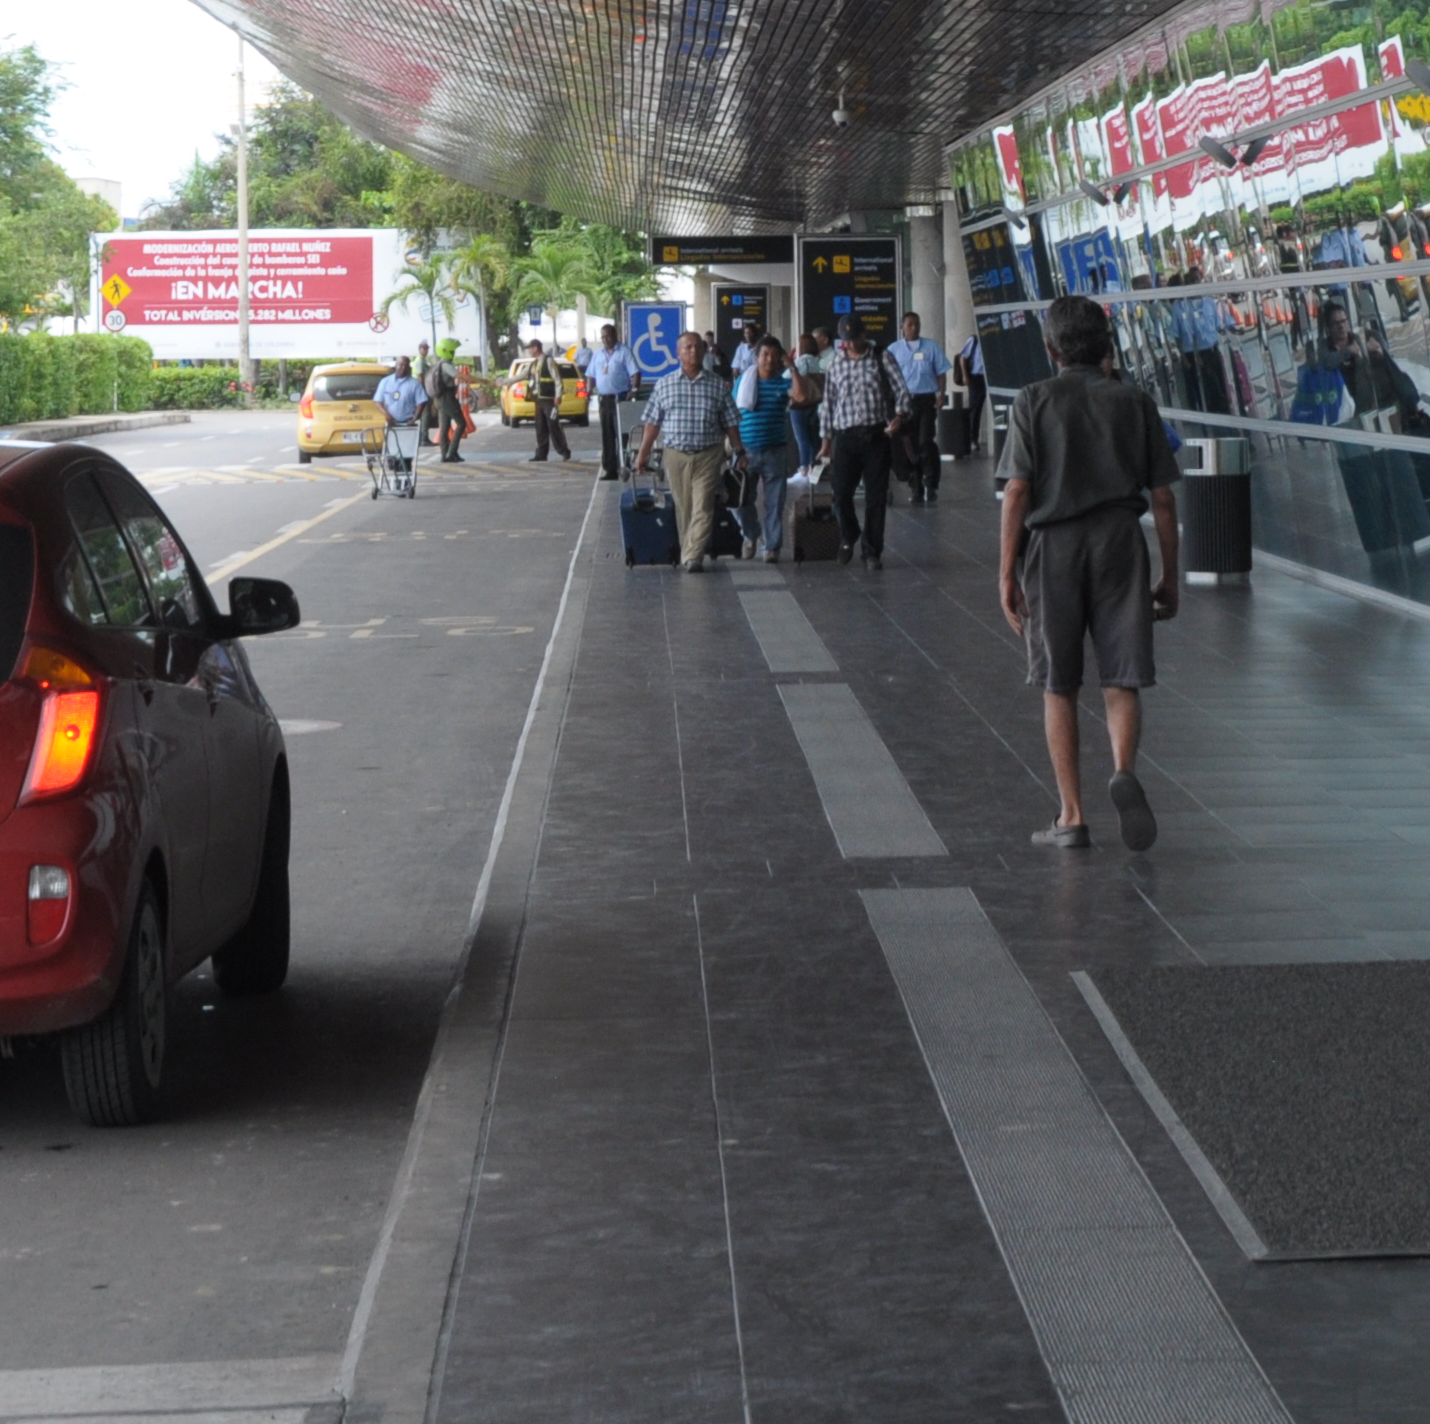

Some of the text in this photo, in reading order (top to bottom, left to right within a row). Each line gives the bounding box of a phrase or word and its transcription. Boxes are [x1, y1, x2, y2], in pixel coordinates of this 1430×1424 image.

[142, 240, 331, 254] MODERNIZACIÓN AEROERTO RAFAEL NUÑEZ
[154, 255, 206, 266] Construcción
[206, 254, 221, 265] del
[252, 254, 264, 265] de
[264, 254, 306, 265] bomberos
[307, 254, 320, 264] SEI
[127, 266, 184, 277] Conformación
[184, 266, 196, 277] de
[208, 266, 234, 278] franja
[276, 266, 326, 276] cerramiento
[171, 281, 203, 300] ¡EN
[109, 315, 123, 326] 30
[144, 309, 181, 321] TOTAL
[278, 308, 331, 320] MILLONES
